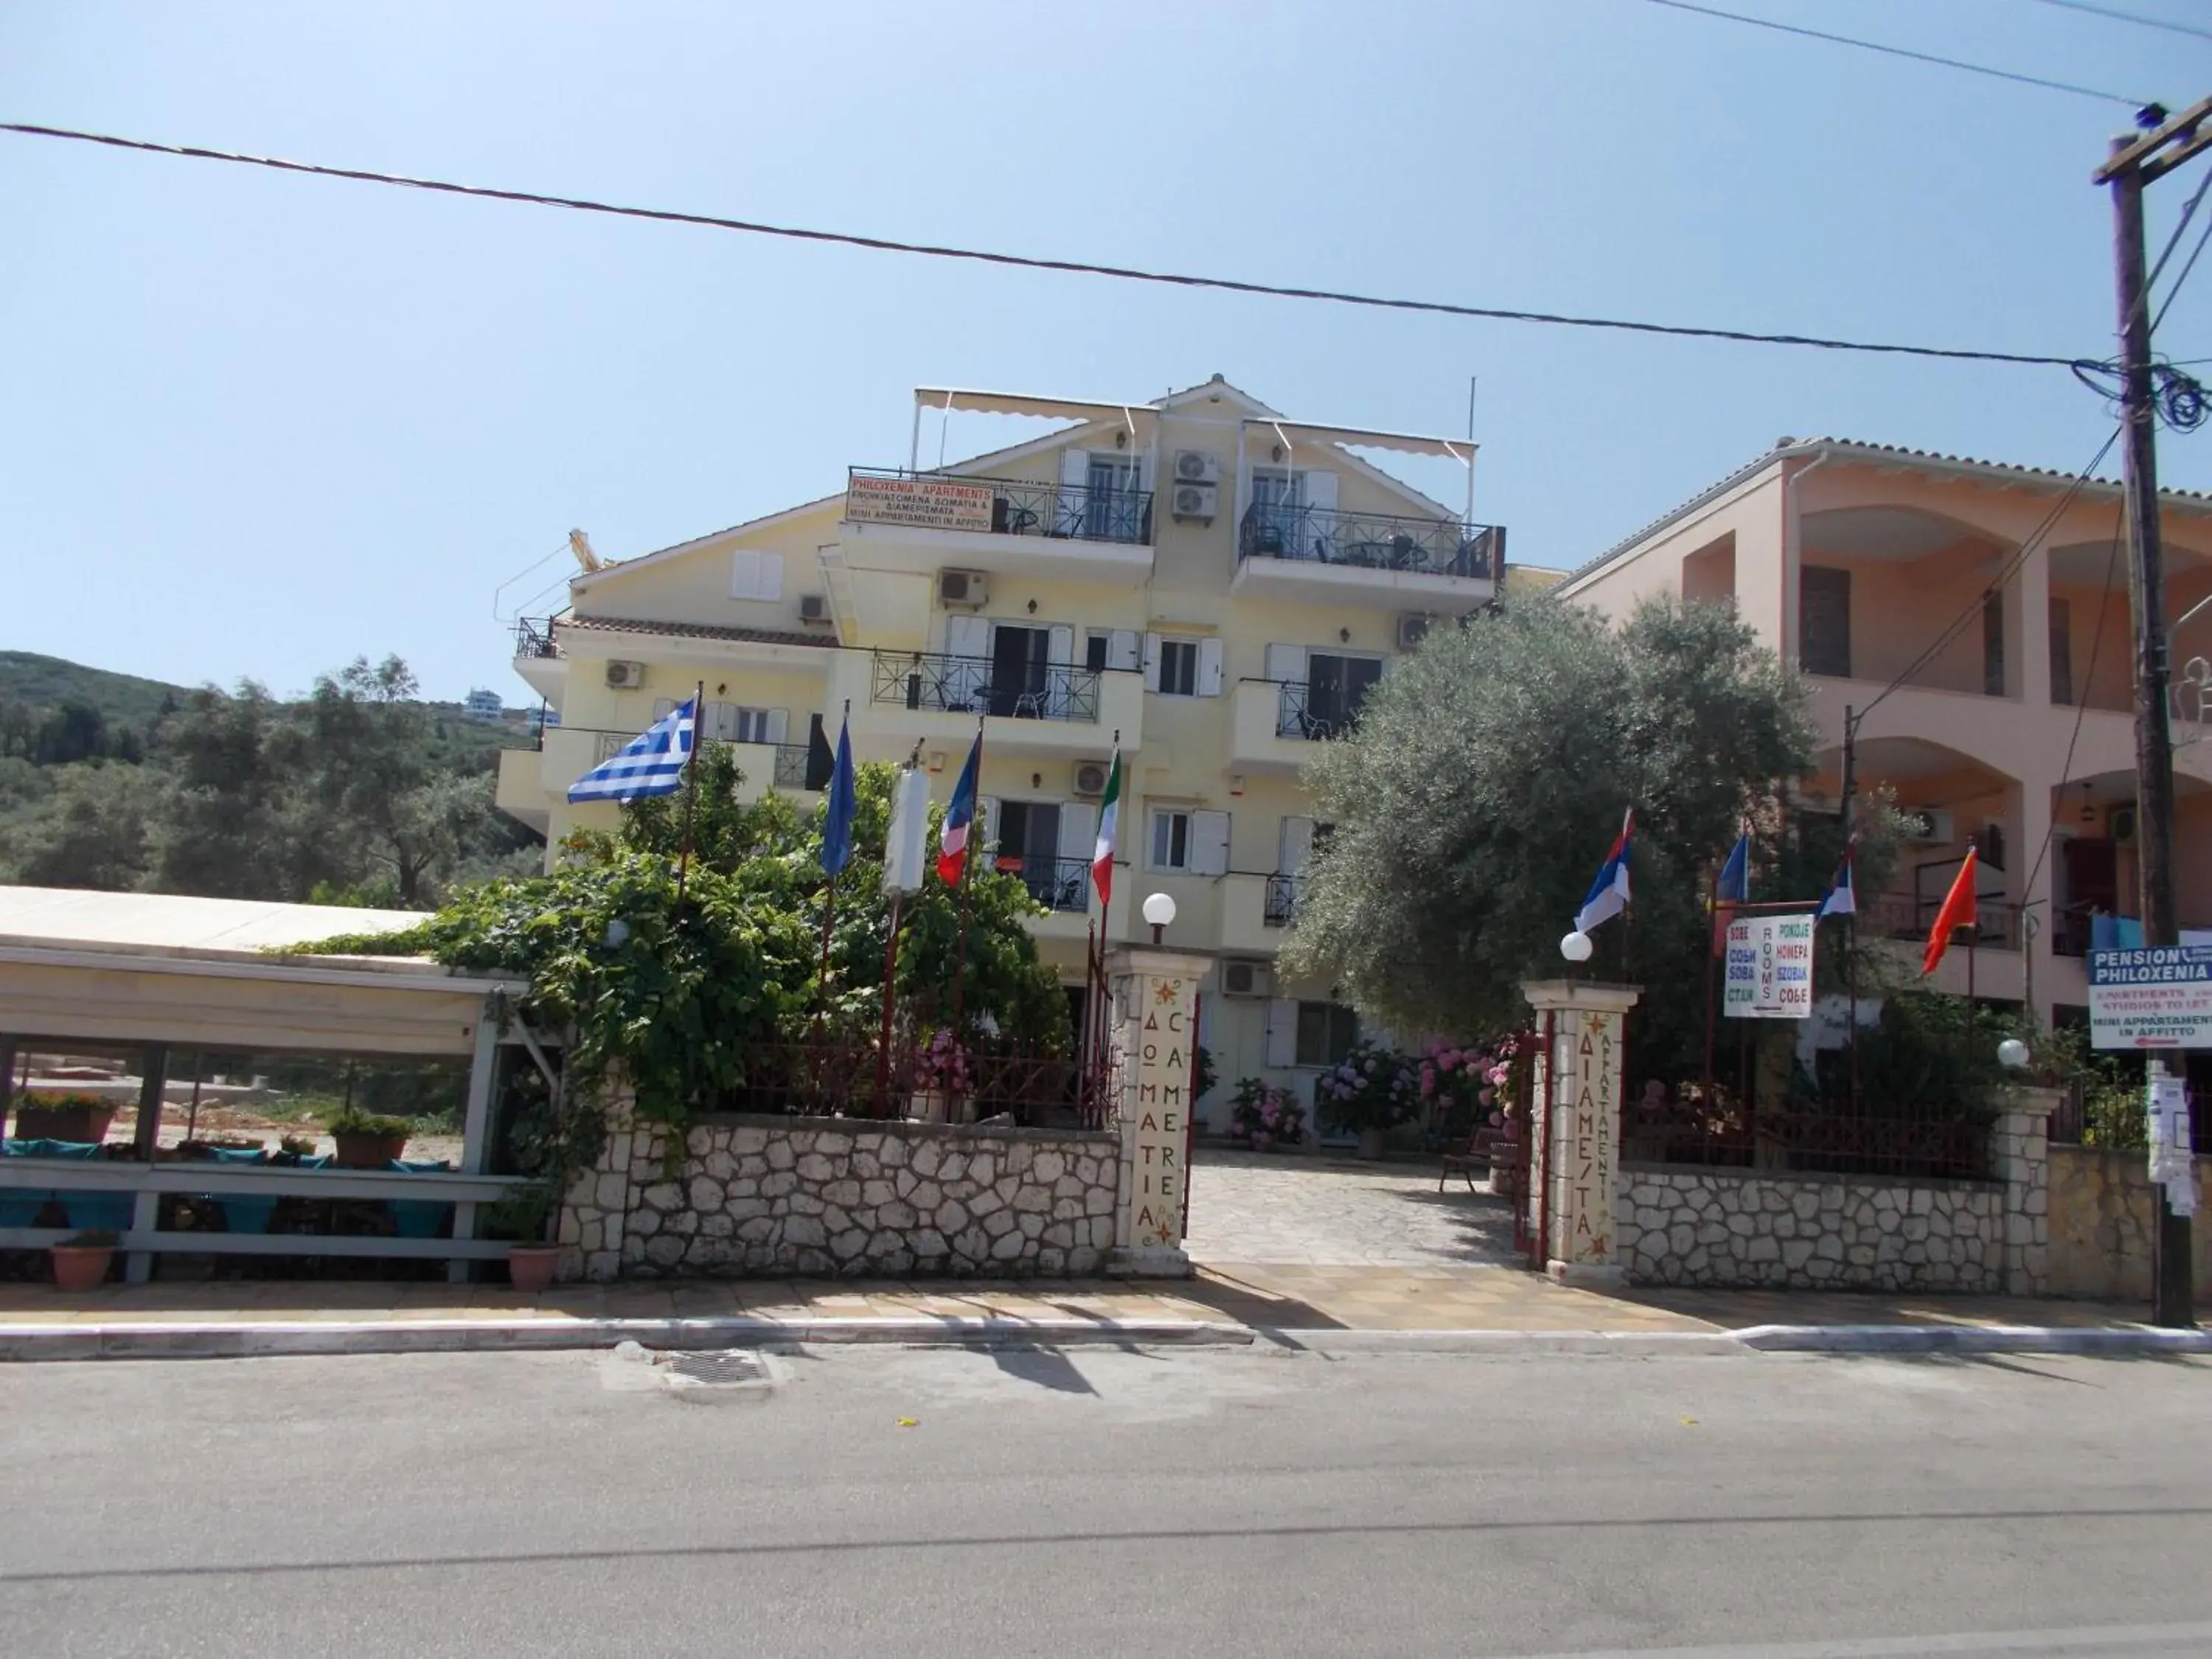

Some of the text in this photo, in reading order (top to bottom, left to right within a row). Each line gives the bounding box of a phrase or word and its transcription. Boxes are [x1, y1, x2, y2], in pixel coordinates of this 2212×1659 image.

[853, 479, 991, 499] PHILOXENIA APARTMENTS
[1762, 928, 1772, 999] ROOMS
[2095, 949, 2180, 967] PENSION
[2096, 964, 2208, 982] PHILOXENIA
[2166, 1000, 2183, 1009] TO
[2093, 1016, 2120, 1026] MINI
[2119, 1026, 2196, 1037] IN AFFITTO
[1161, 1012, 1183, 1196] CAMERE
